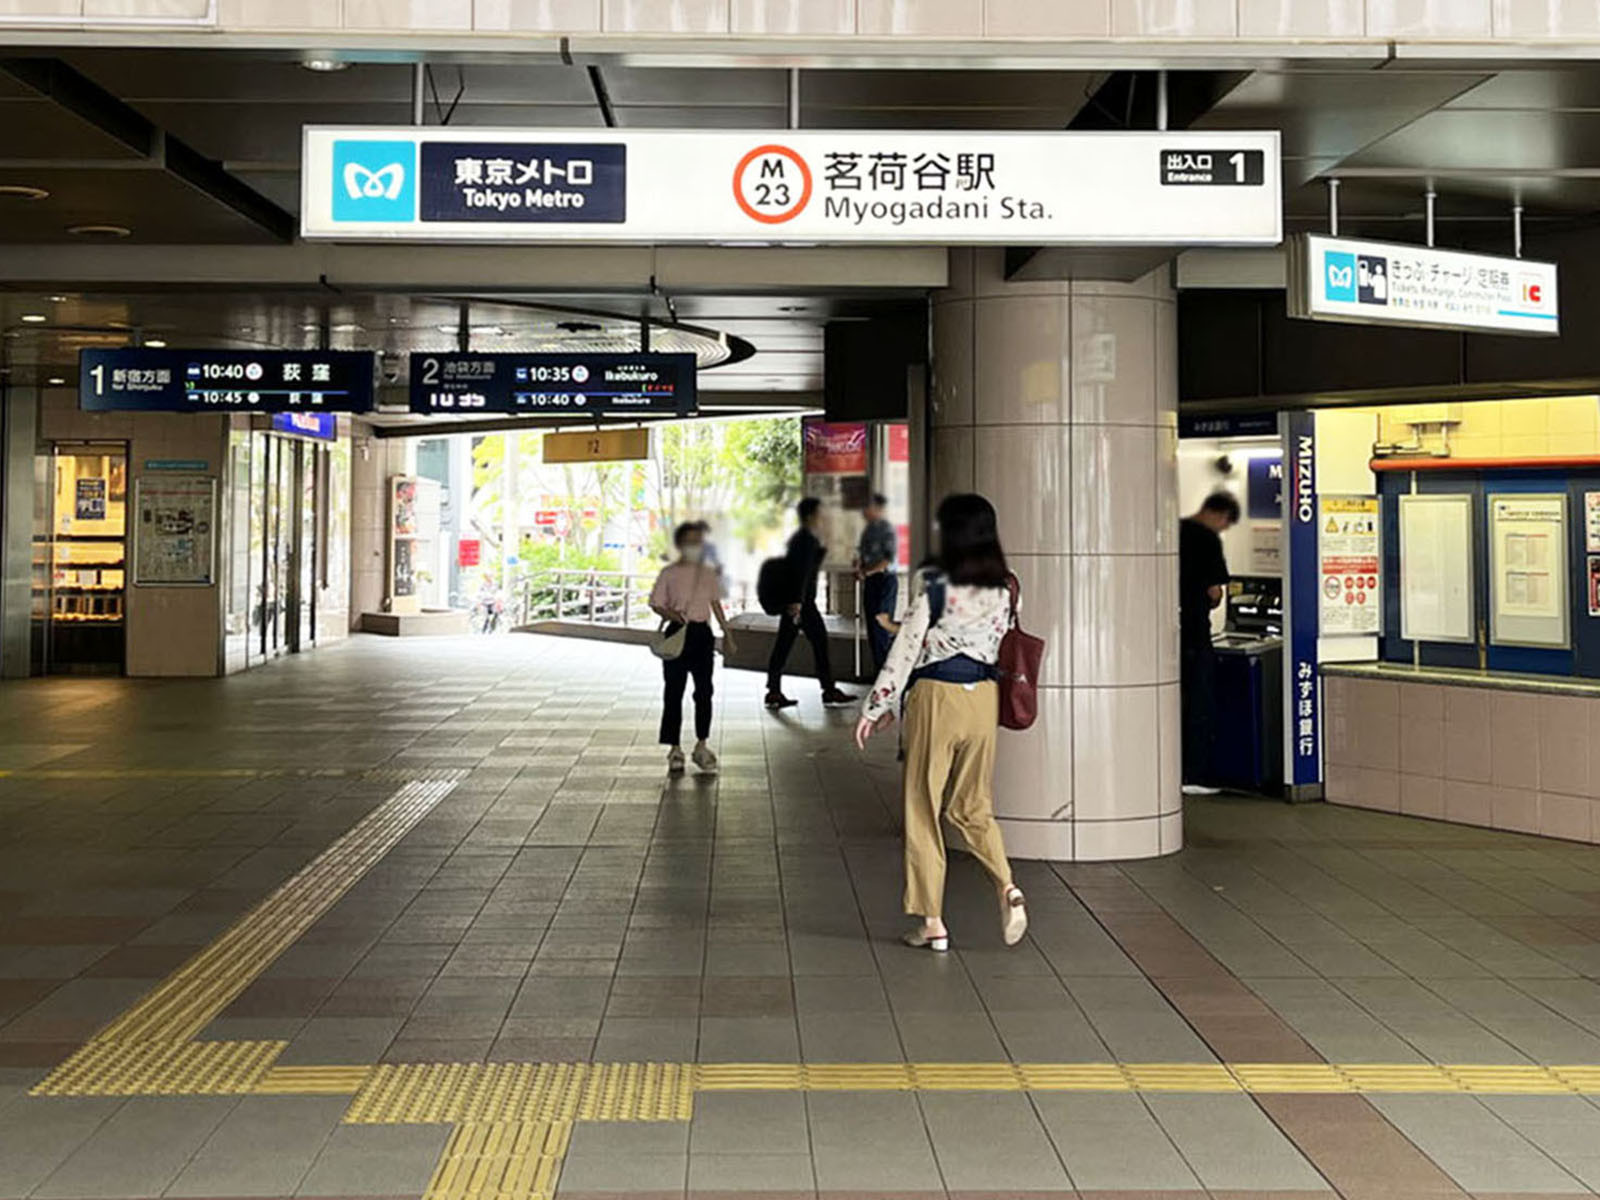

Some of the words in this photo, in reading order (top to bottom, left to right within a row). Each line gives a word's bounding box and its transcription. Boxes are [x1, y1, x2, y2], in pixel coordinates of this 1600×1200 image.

[454, 157, 593, 186] 東京メトロ
[760, 159, 785, 179] M
[824, 151, 996, 192] 茗荷谷駅
[1166, 154, 1213, 170] 出入口
[1229, 152, 1245, 183] 1
[462, 188, 522, 212] Tokyo
[526, 188, 585, 208] Metro
[755, 183, 790, 206] 23
[824, 195, 989, 226] Myogadani
[1000, 196, 1053, 220] Sta.
[90, 364, 104, 395] 1
[202, 364, 244, 379] 10:40
[422, 358, 439, 385] 2
[530, 366, 570, 382] 10:35
[202, 392, 243, 404] 10:45
[530, 393, 570, 406] 10:40
[1298, 436, 1313, 522] MIZUHO
